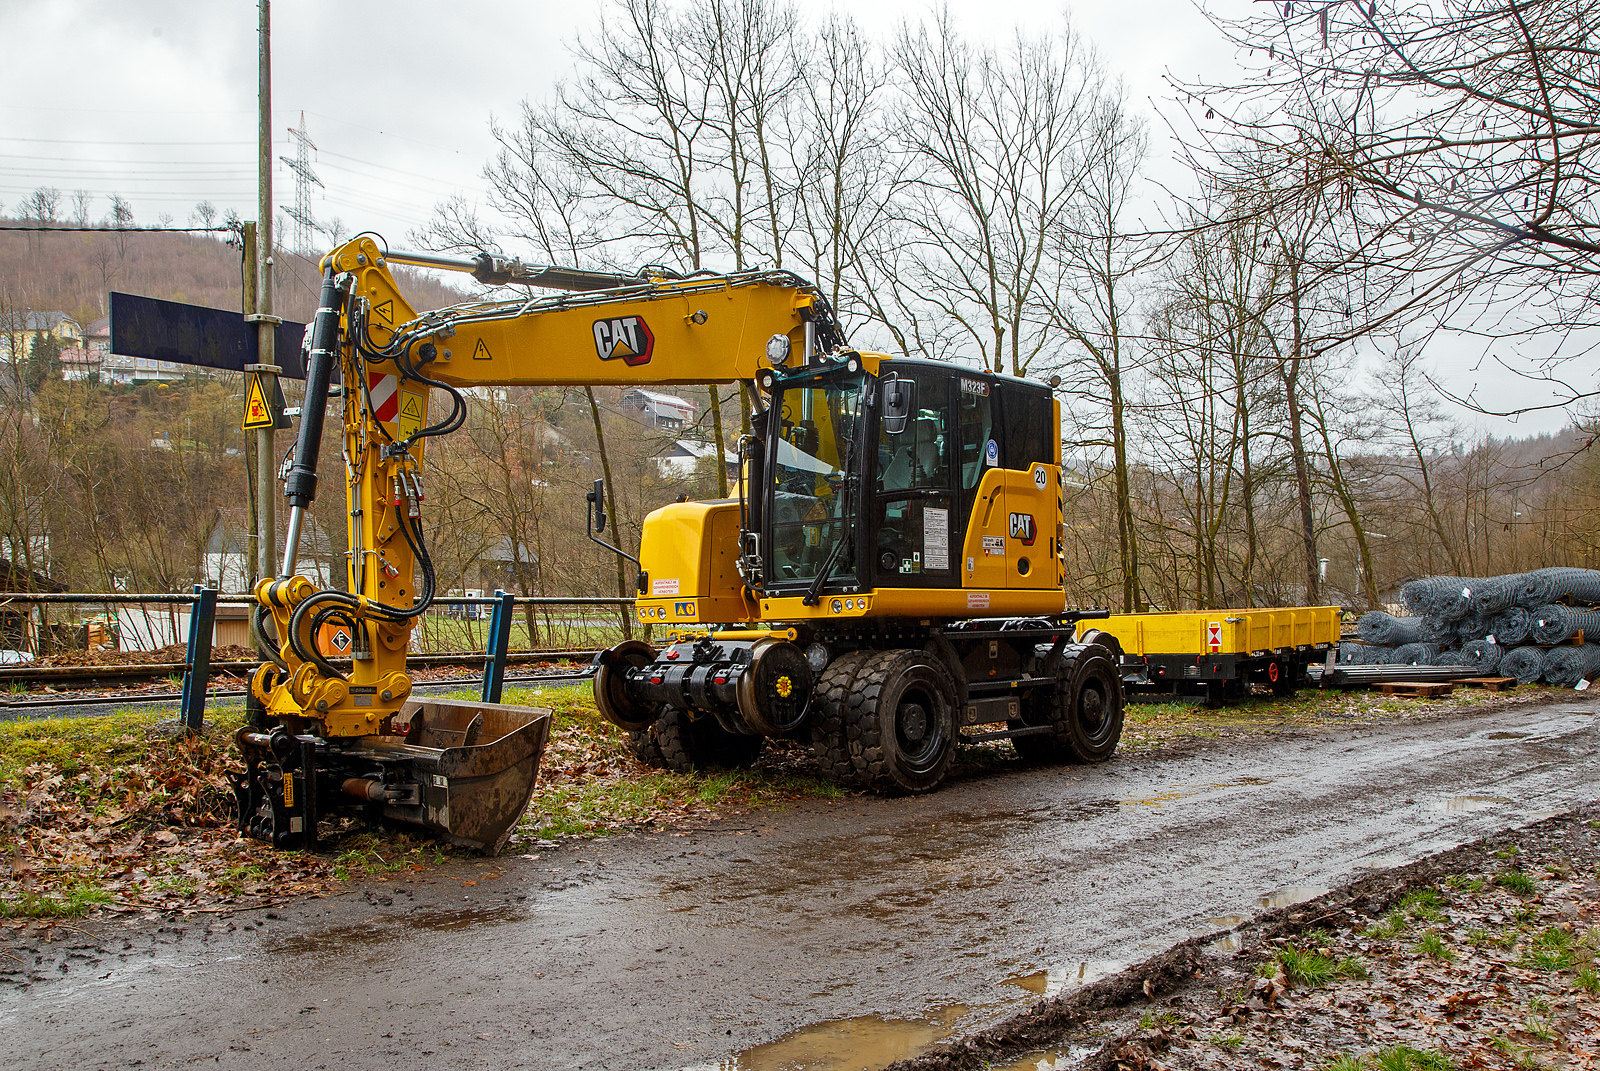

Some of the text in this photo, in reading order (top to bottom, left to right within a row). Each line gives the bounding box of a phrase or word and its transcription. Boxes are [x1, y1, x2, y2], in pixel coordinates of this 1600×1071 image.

[593, 317, 639, 359] CAT
[960, 378, 986, 395] M323F
[1035, 470, 1046, 485] 20
[1009, 513, 1031, 539] CAT
[337, 633, 344, 647] F
